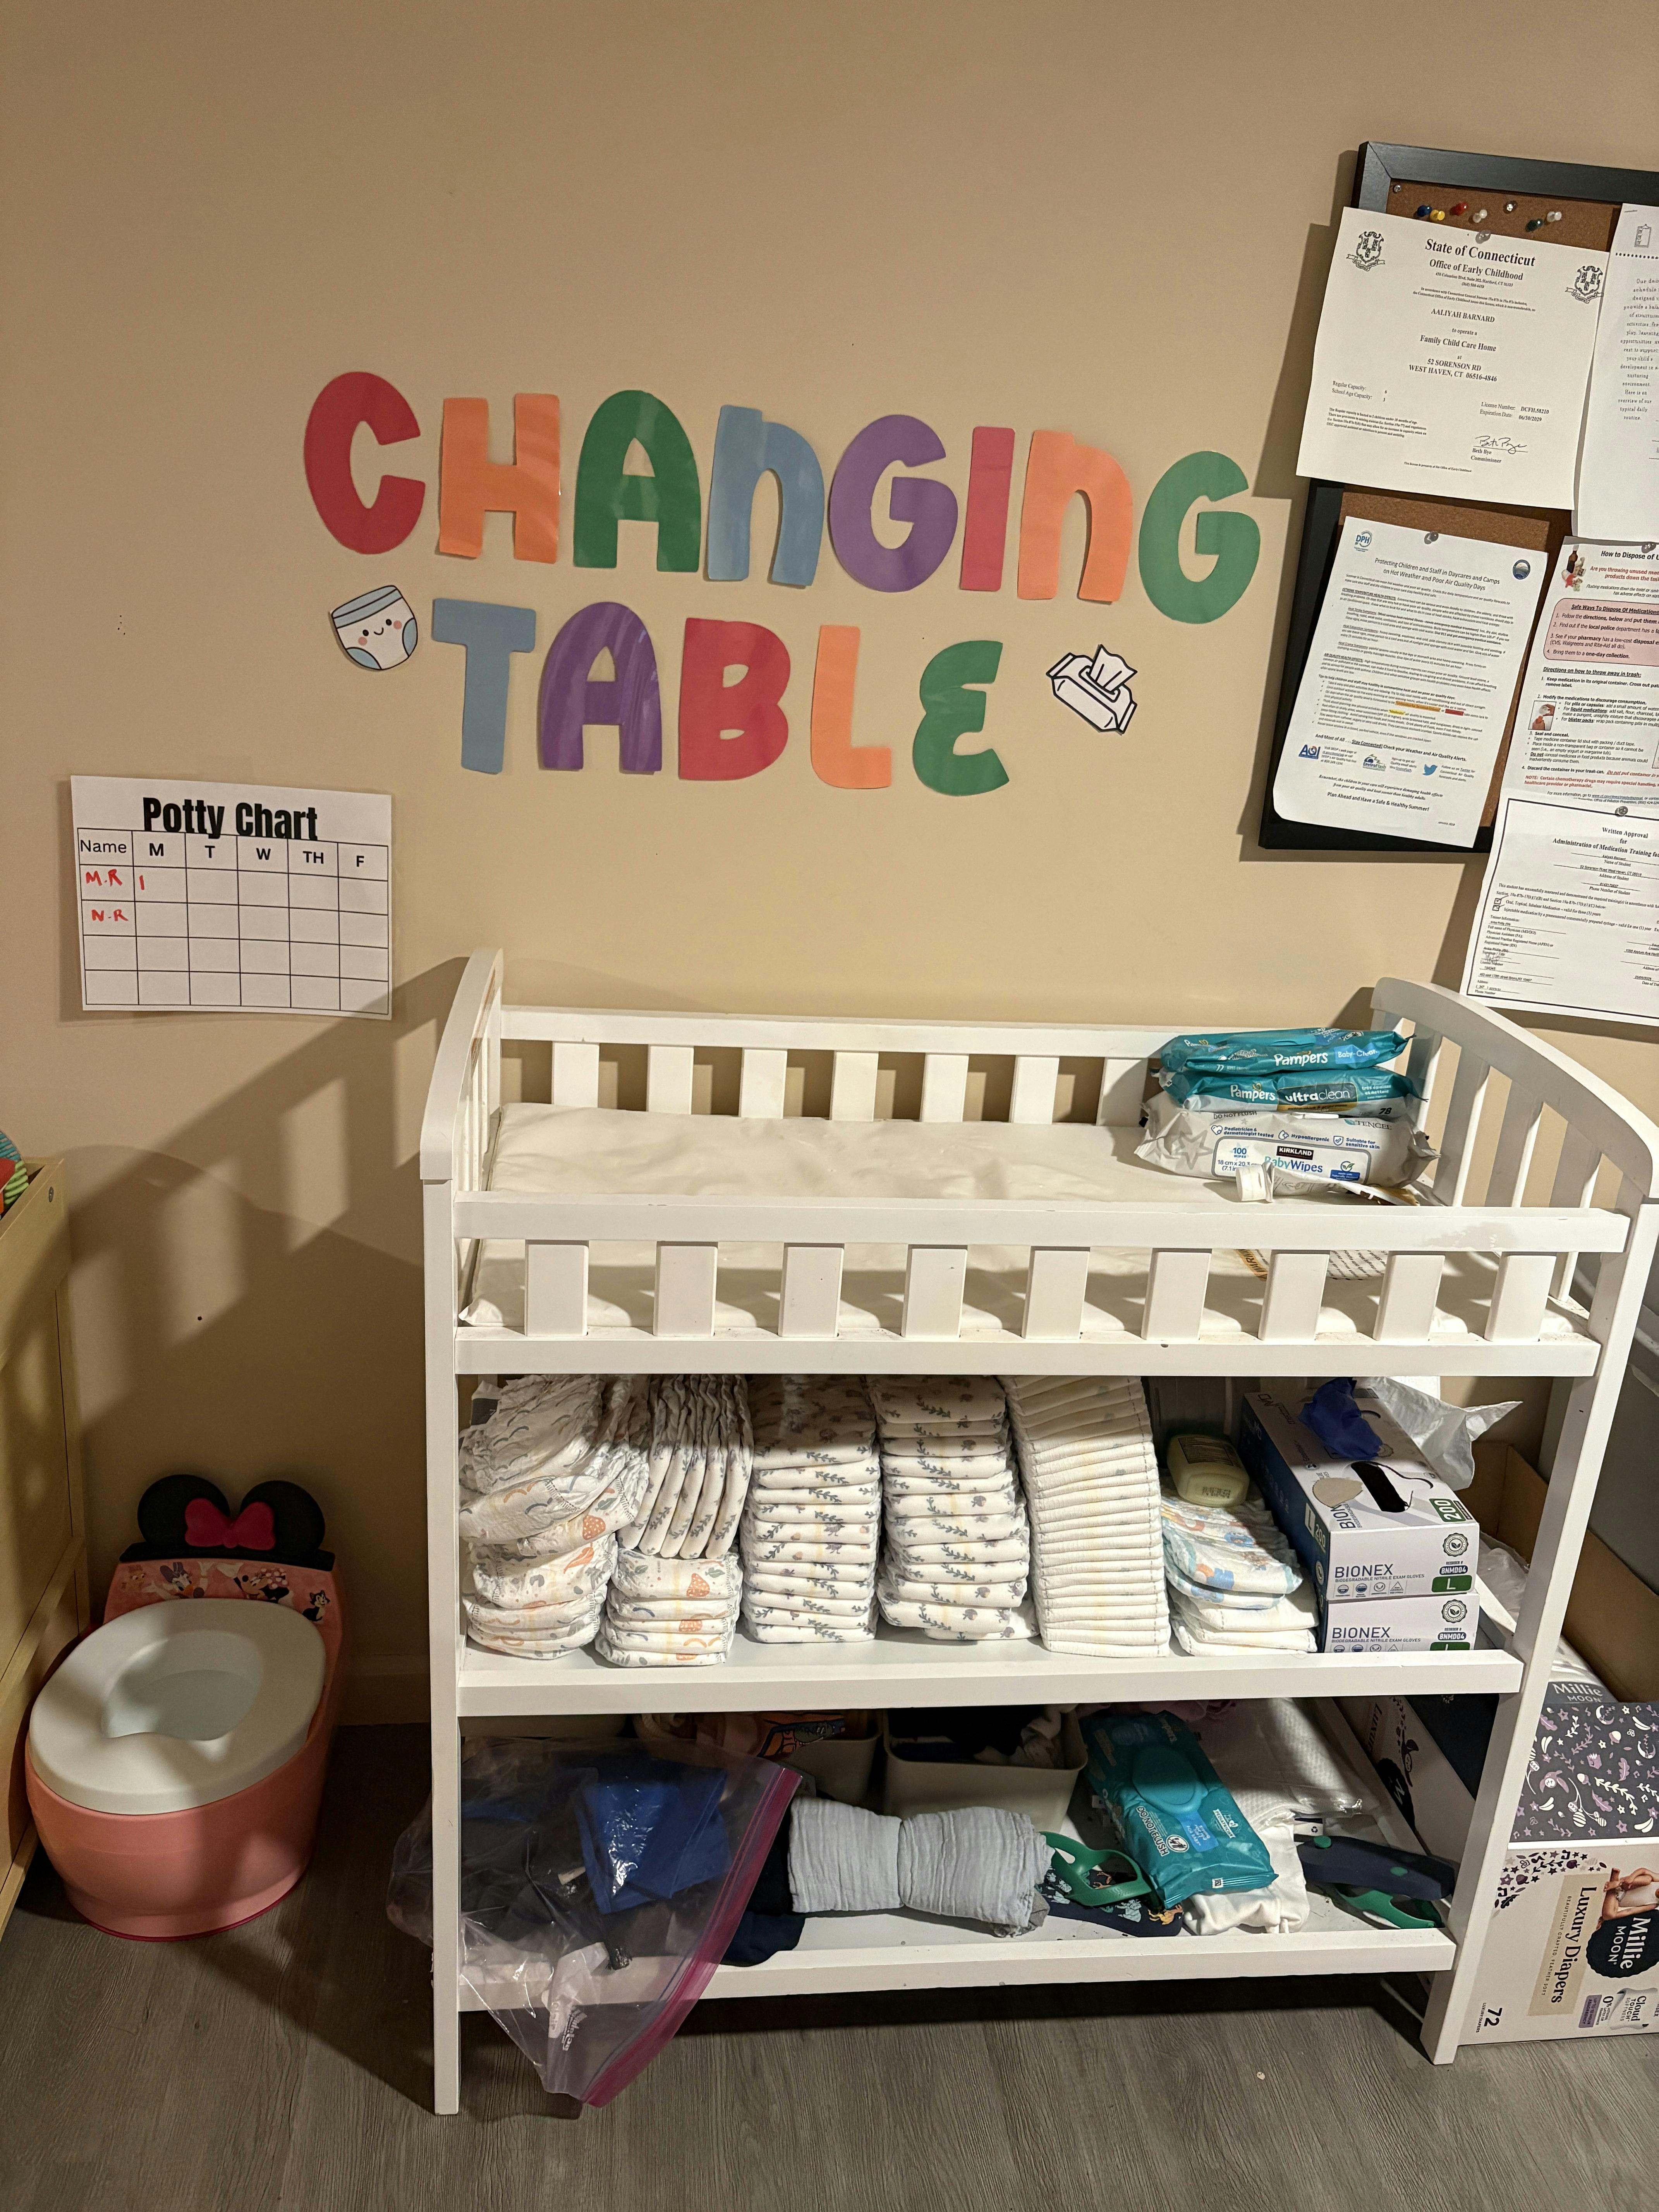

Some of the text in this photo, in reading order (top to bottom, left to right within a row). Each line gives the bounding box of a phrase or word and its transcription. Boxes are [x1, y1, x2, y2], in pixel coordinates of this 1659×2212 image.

[1425, 239, 1535, 266] State of Connecticut
[1429, 259, 1451, 270] Office
[1462, 264, 1483, 276] Early
[1484, 267, 1523, 280] Childhood
[1431, 308, 1495, 322] AALIYAH BARNARD
[1420, 334, 1496, 351] Family Child Care Home
[1409, 364, 1427, 373] WEST
[1428, 367, 1452, 377] HAVEN,
[1465, 372, 1497, 381] 06516-4846
[1435, 359, 1470, 369] SORENSON
[1355, 534, 1370, 544] DPH
[1622, 551, 1645, 560] Dispose
[1374, 557, 1398, 568] Protecting
[1398, 562, 1418, 570] Children
[1448, 570, 1472, 579] Daycares
[1483, 576, 1500, 585] Camps
[1400, 571, 1421, 579] Weather
[1453, 580, 1473, 590] Quality
[432, 598, 1010, 797] TABLE
[143, 797, 318, 841] Potty Chart
[1602, 827, 1648, 838] Written Approval
[80, 839, 365, 867] Name M T W TH F
[1552, 838, 1592, 848] Administration
[1598, 843, 1628, 853] Medication
[1629, 848, 1652, 857] Training
[1273, 1052, 1328, 1066] Pampers
[1230, 1084, 1276, 1102] Pampers
[1285, 1090, 1350, 1103] ultraclean
[1357, 1120, 1391, 1130] TENCEL
[1291, 1133, 1329, 1142] Hypoallergenic
[1279, 1147, 1312, 1156] KIRKLAND
[1434, 1499, 1462, 1521] 200
[1315, 1525, 1326, 1545] 200
[1334, 1563, 1394, 1578] BIONEX
[1441, 1566, 1467, 1574] BNMD04
[1446, 1578, 1456, 1590] L
[1332, 1626, 1391, 1639] BIONEX
[1552, 1683, 1603, 1697] Millie
[1135, 1805, 1169, 1857] DO NOT FLUSH
[1558, 1896, 1571, 1930] BEAUTIFULLY
[1550, 1887, 1597, 2004] Luxury Diapers
[1619, 1917, 1651, 1970] Millie
[1544, 1959, 1555, 1982] FEATHER
[1482, 2007, 1502, 2027] 72
[1620, 1997, 1630, 2022] SOFTNESS
[1630, 1996, 1646, 2021] Cloud
